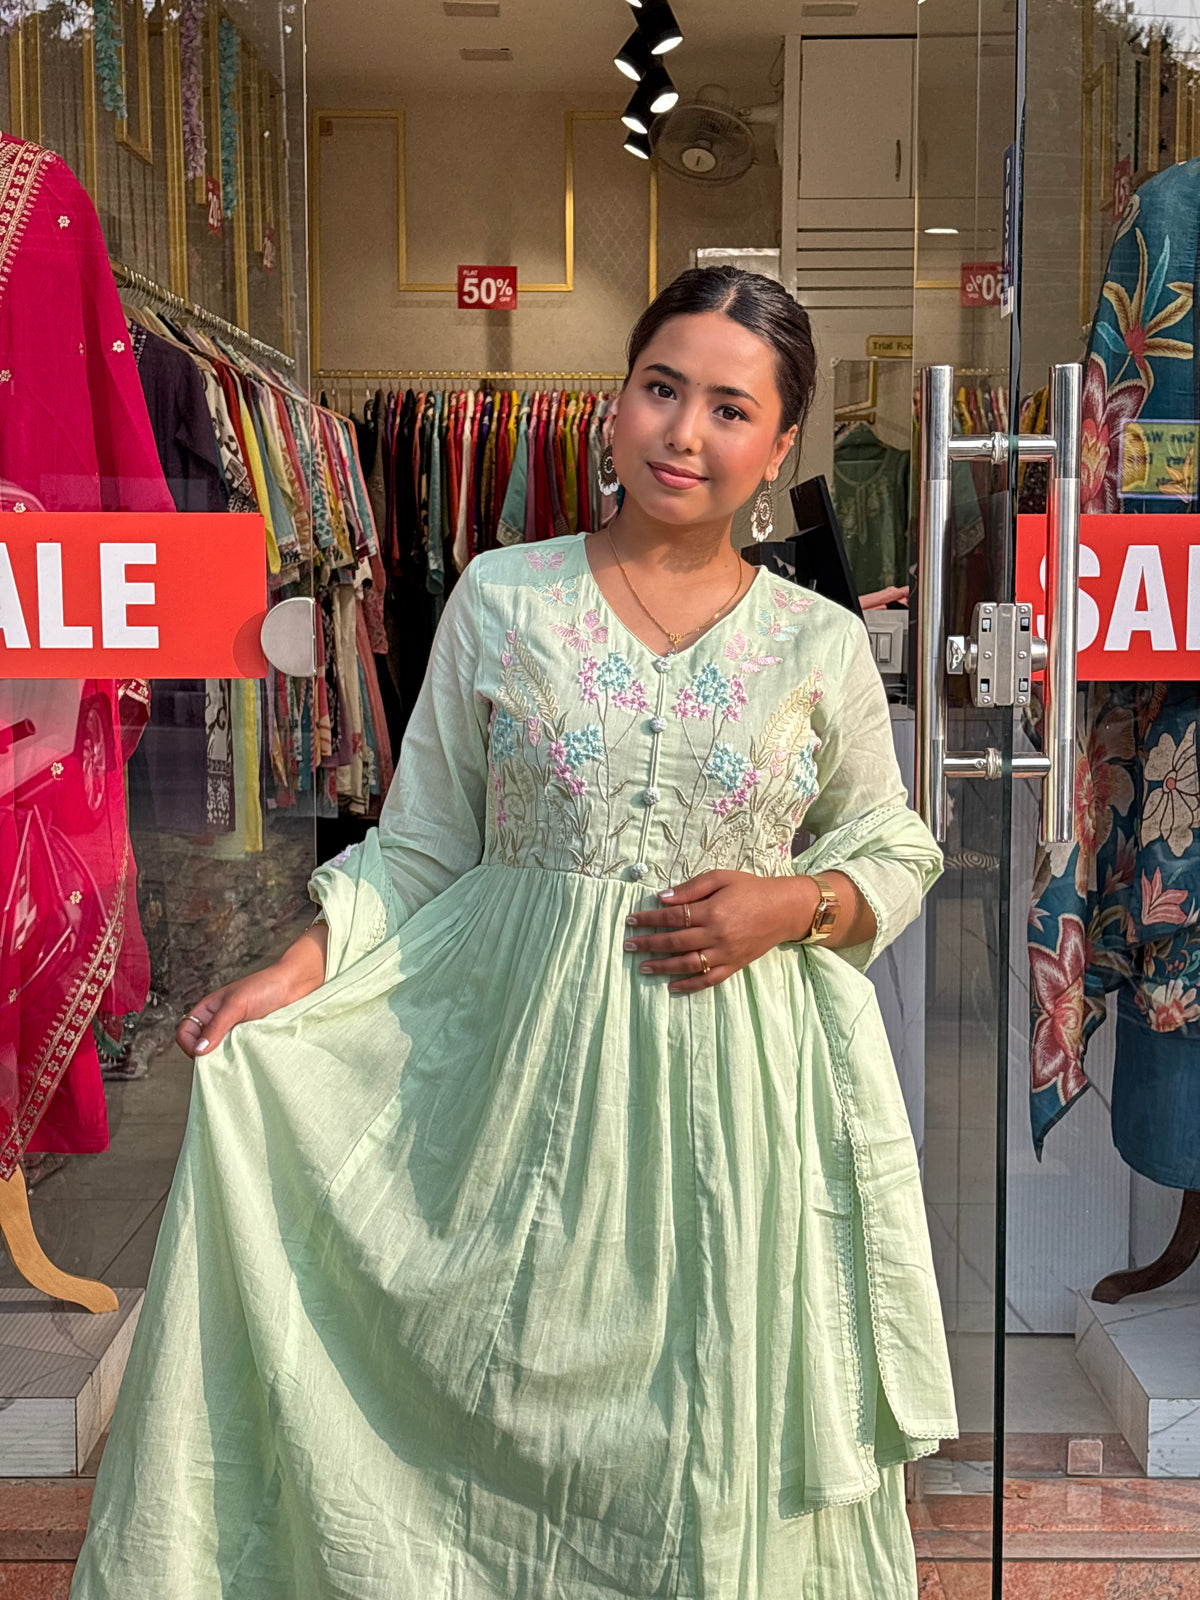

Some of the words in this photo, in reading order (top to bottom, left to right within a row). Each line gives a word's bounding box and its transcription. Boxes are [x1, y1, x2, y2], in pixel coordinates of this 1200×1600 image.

[462, 277, 513, 304] 50%
[872, 341, 893, 350] Trial
[1037, 543, 1200, 652] SA
